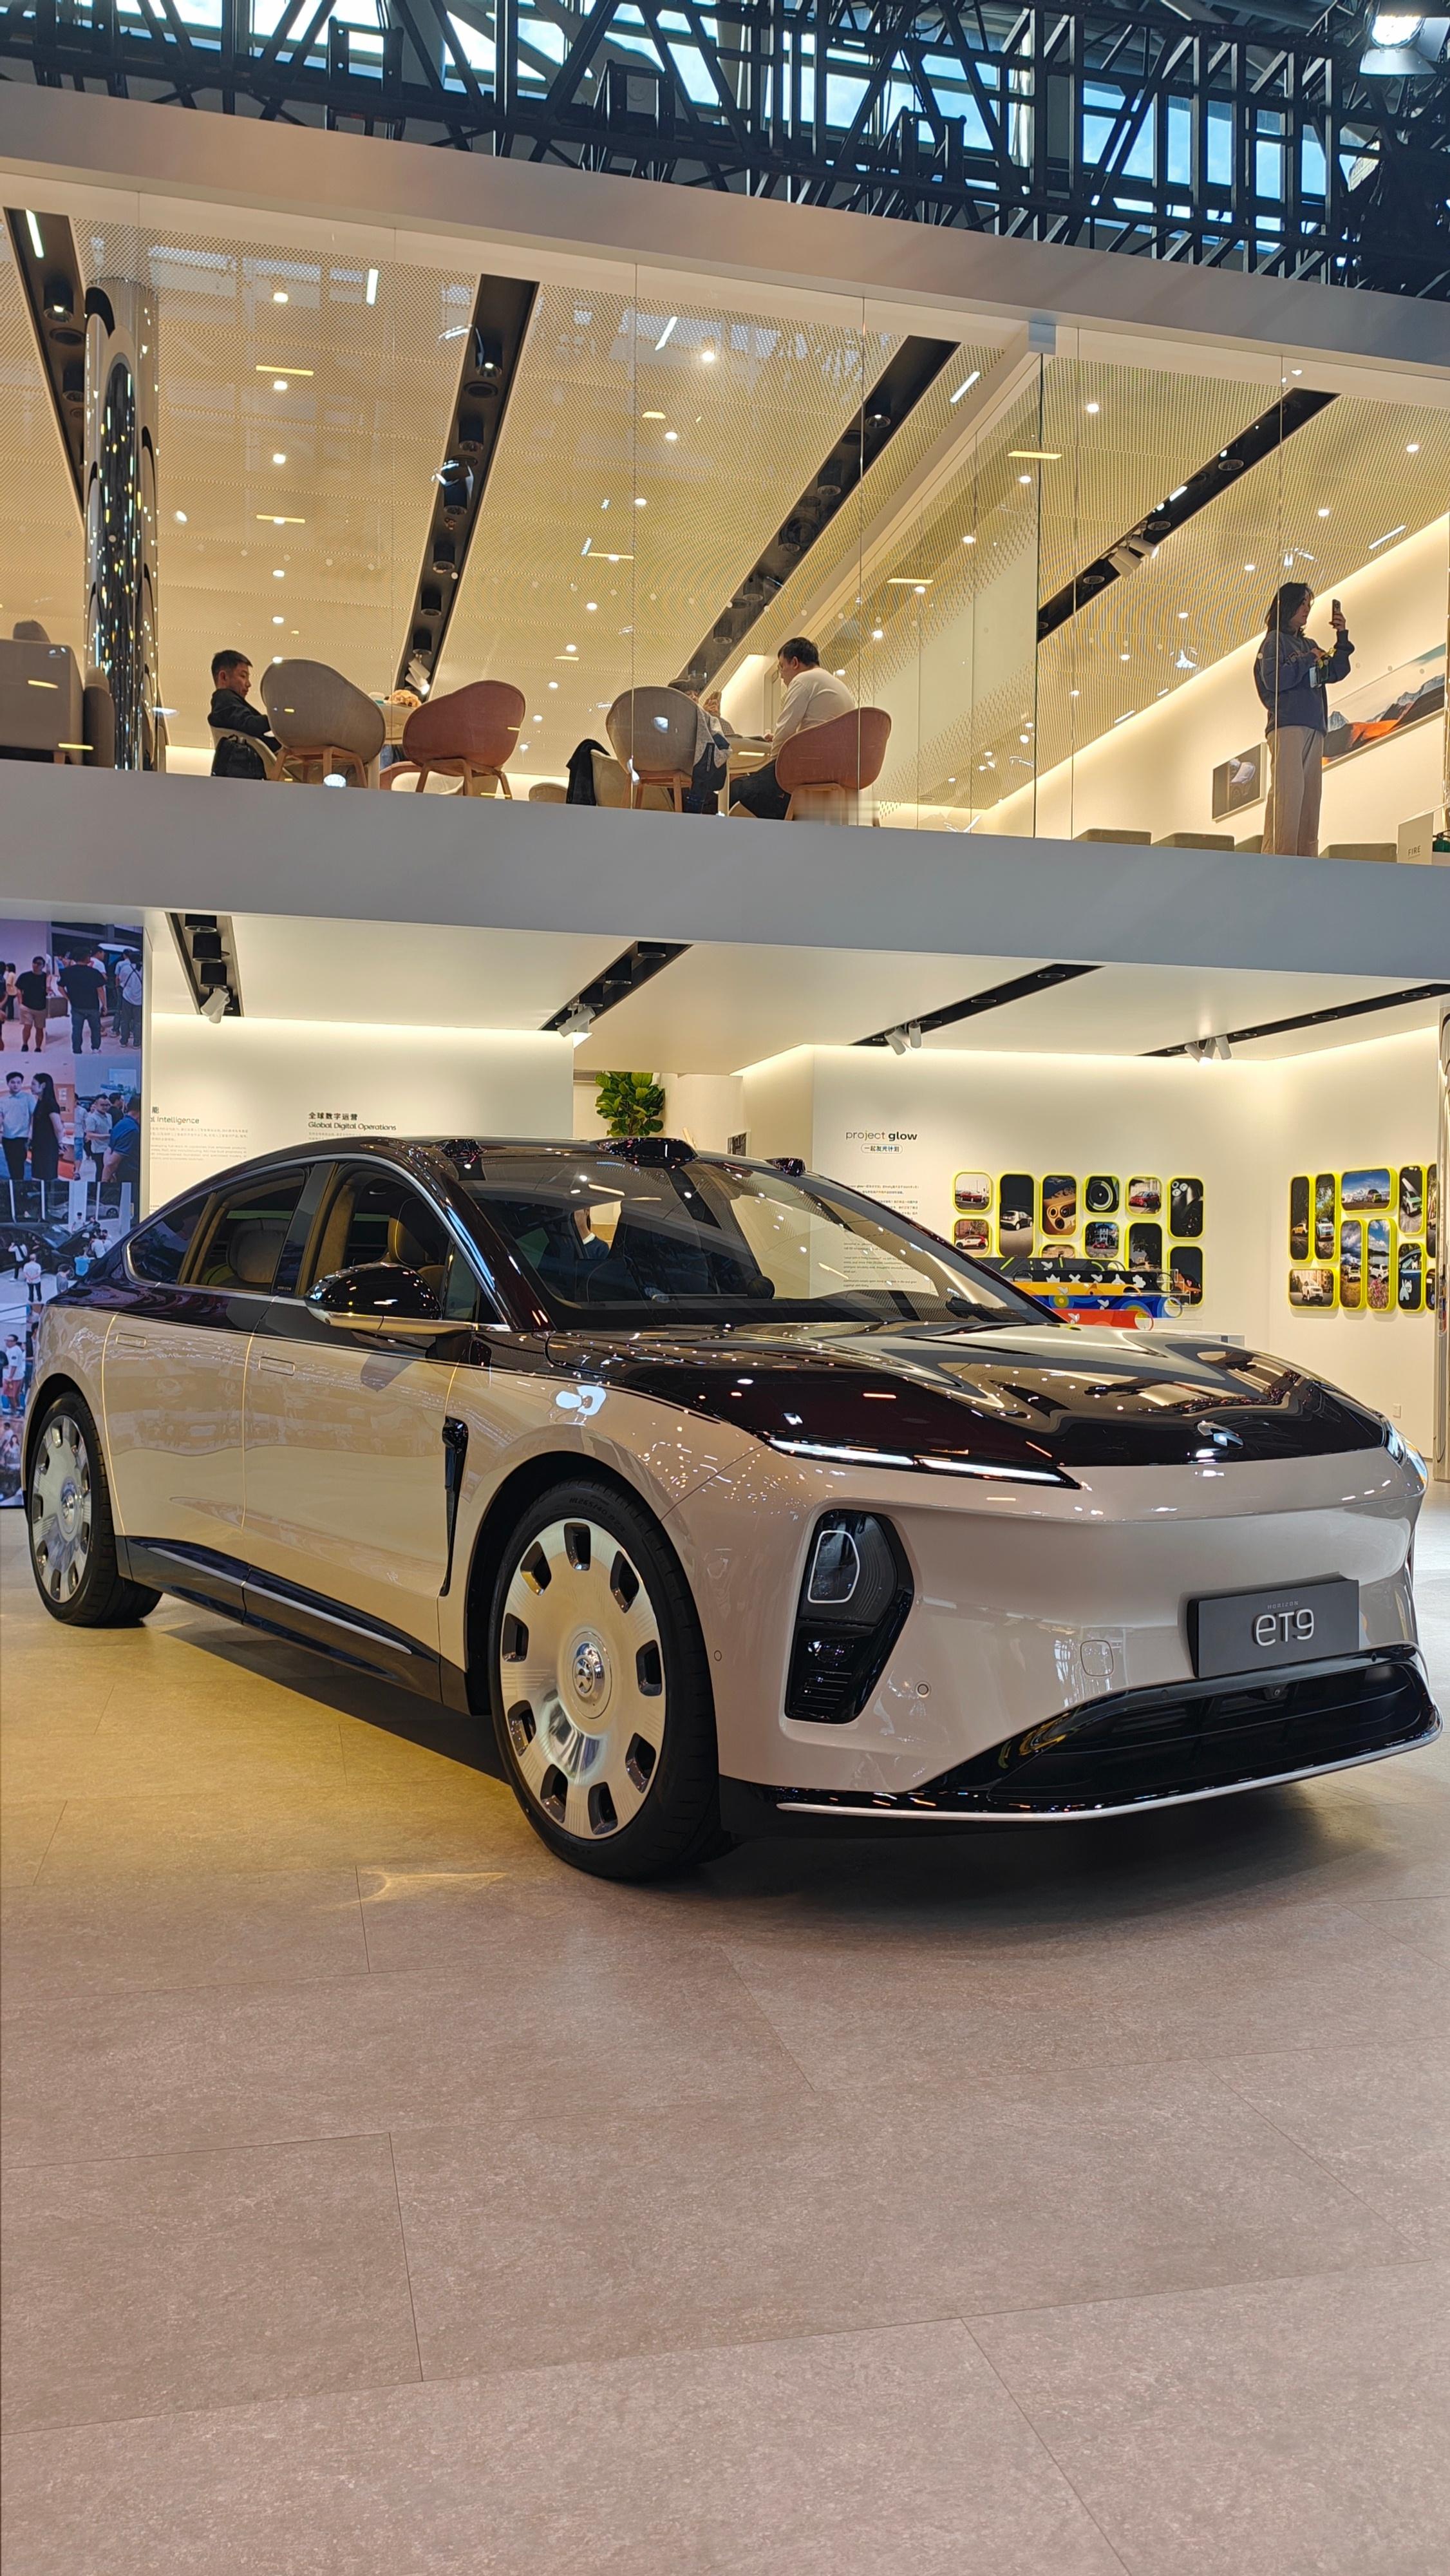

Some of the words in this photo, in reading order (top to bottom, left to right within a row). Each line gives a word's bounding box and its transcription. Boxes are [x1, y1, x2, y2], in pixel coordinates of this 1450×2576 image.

[1408, 845, 1421, 857] FIRE
[308, 1112, 358, 1121] 全球数字运营
[334, 1122, 357, 1130] Digital
[357, 1123, 397, 1132] Operations
[845, 1130, 886, 1141] project
[888, 1132, 918, 1142] glow
[1267, 1600, 1299, 1609] HORIZON
